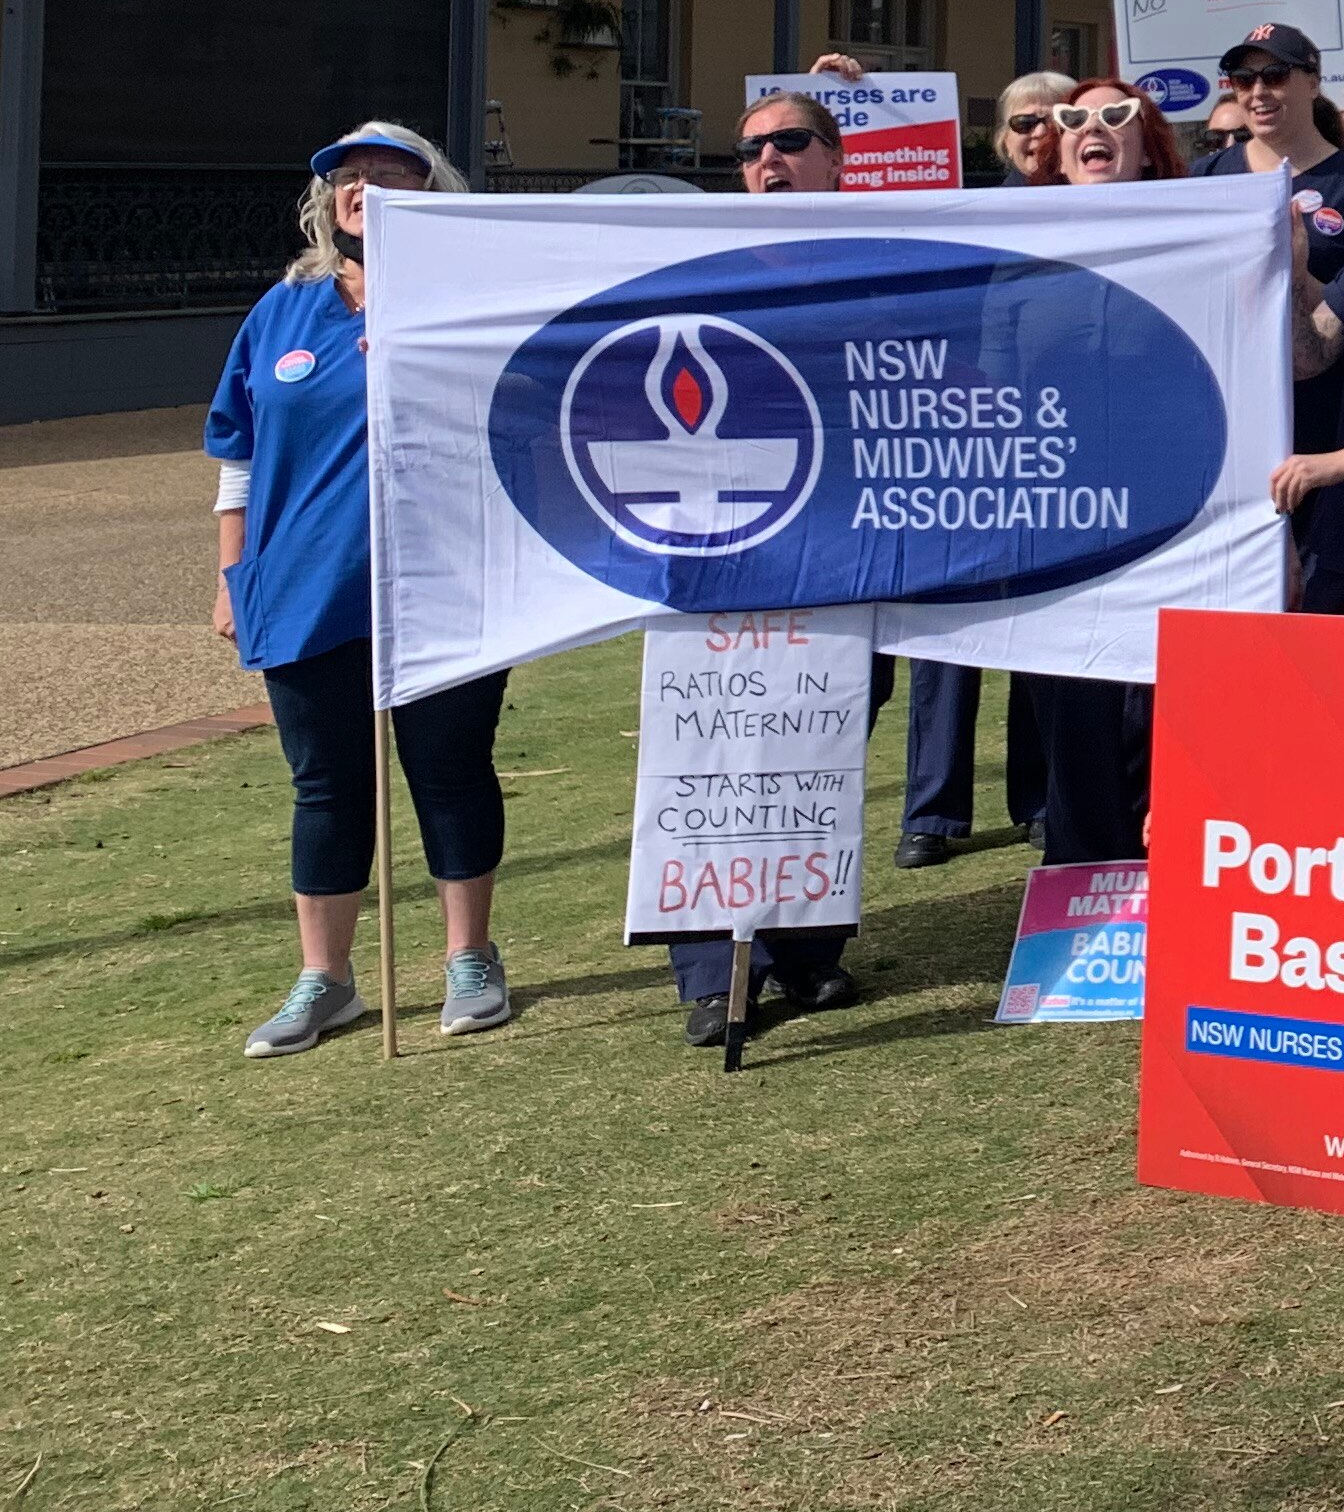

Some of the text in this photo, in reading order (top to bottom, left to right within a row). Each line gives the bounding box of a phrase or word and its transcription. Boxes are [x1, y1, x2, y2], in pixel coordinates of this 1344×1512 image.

[812, 87, 937, 106] urses are
[842, 164, 949, 188] ong inside
[845, 338, 948, 381] NSW
[848, 387, 1068, 431] NURSES &
[852, 438, 1076, 479] MIDWIVES'
[851, 487, 1129, 530] ASSOCIATION
[705, 611, 813, 653] SAFE
[660, 670, 829, 702] RATIOS IN
[675, 708, 850, 741] MATERNITY
[676, 771, 844, 798] STARTS WITH
[658, 801, 837, 832] COUNTING
[658, 850, 854, 913] BABIES!!
[1067, 893, 1149, 917] MATT
[1191, 1019, 1244, 1047] NSW
[1249, 1026, 1341, 1061] NURSES
